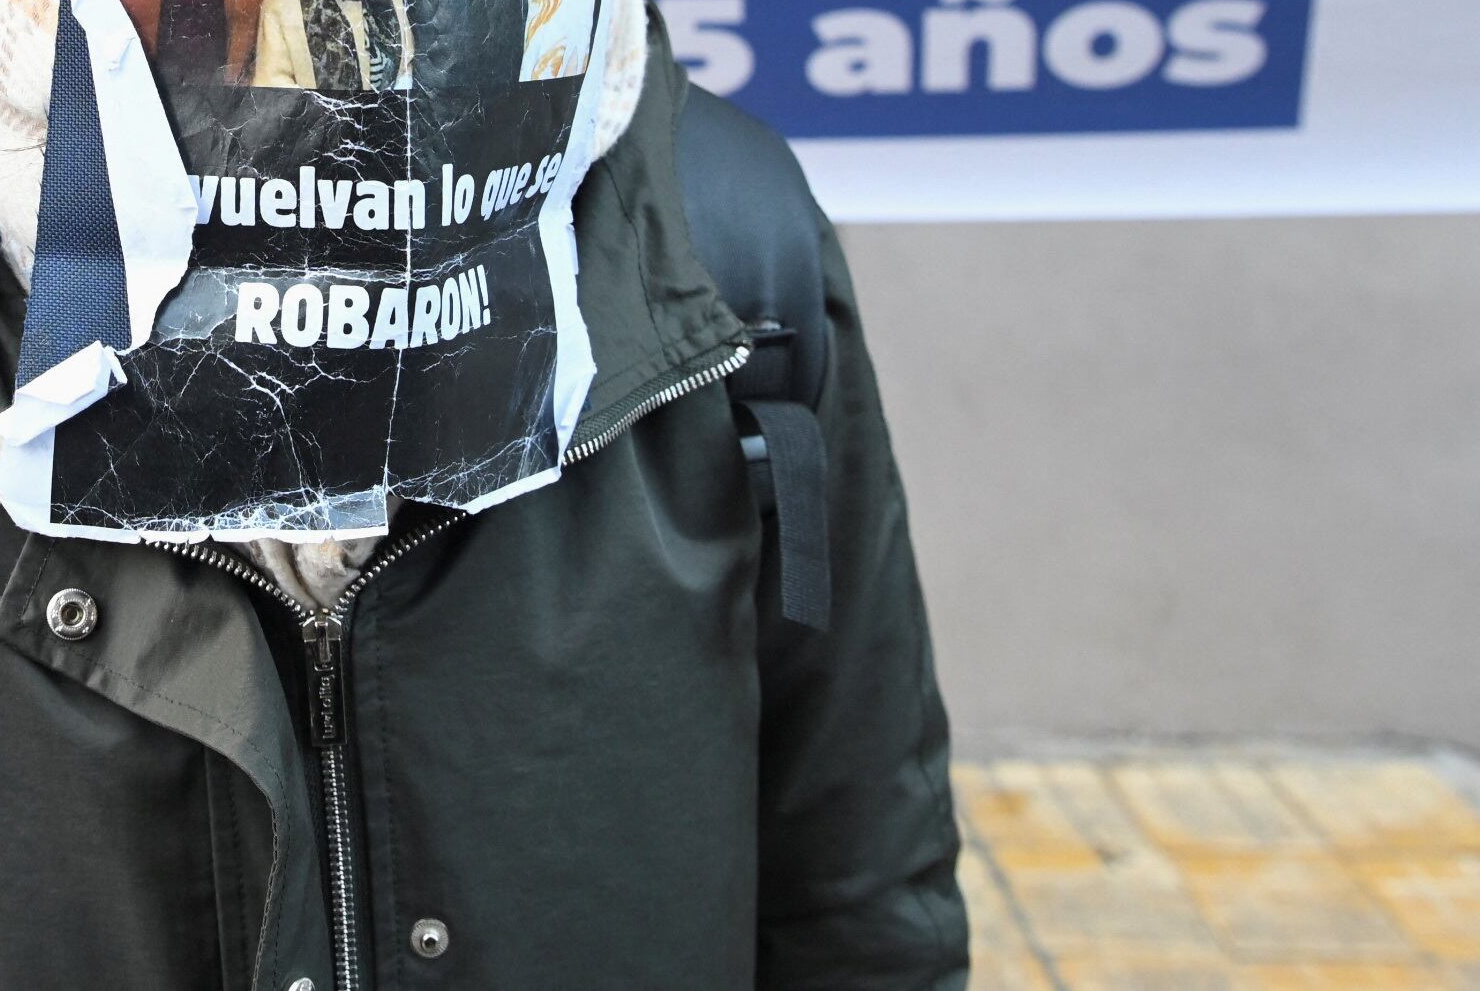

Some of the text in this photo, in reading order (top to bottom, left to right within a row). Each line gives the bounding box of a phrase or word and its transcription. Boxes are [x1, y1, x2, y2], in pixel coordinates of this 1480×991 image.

[441, 163, 475, 226] lo
[480, 161, 532, 222] que
[234, 264, 491, 350] ROBARON!
